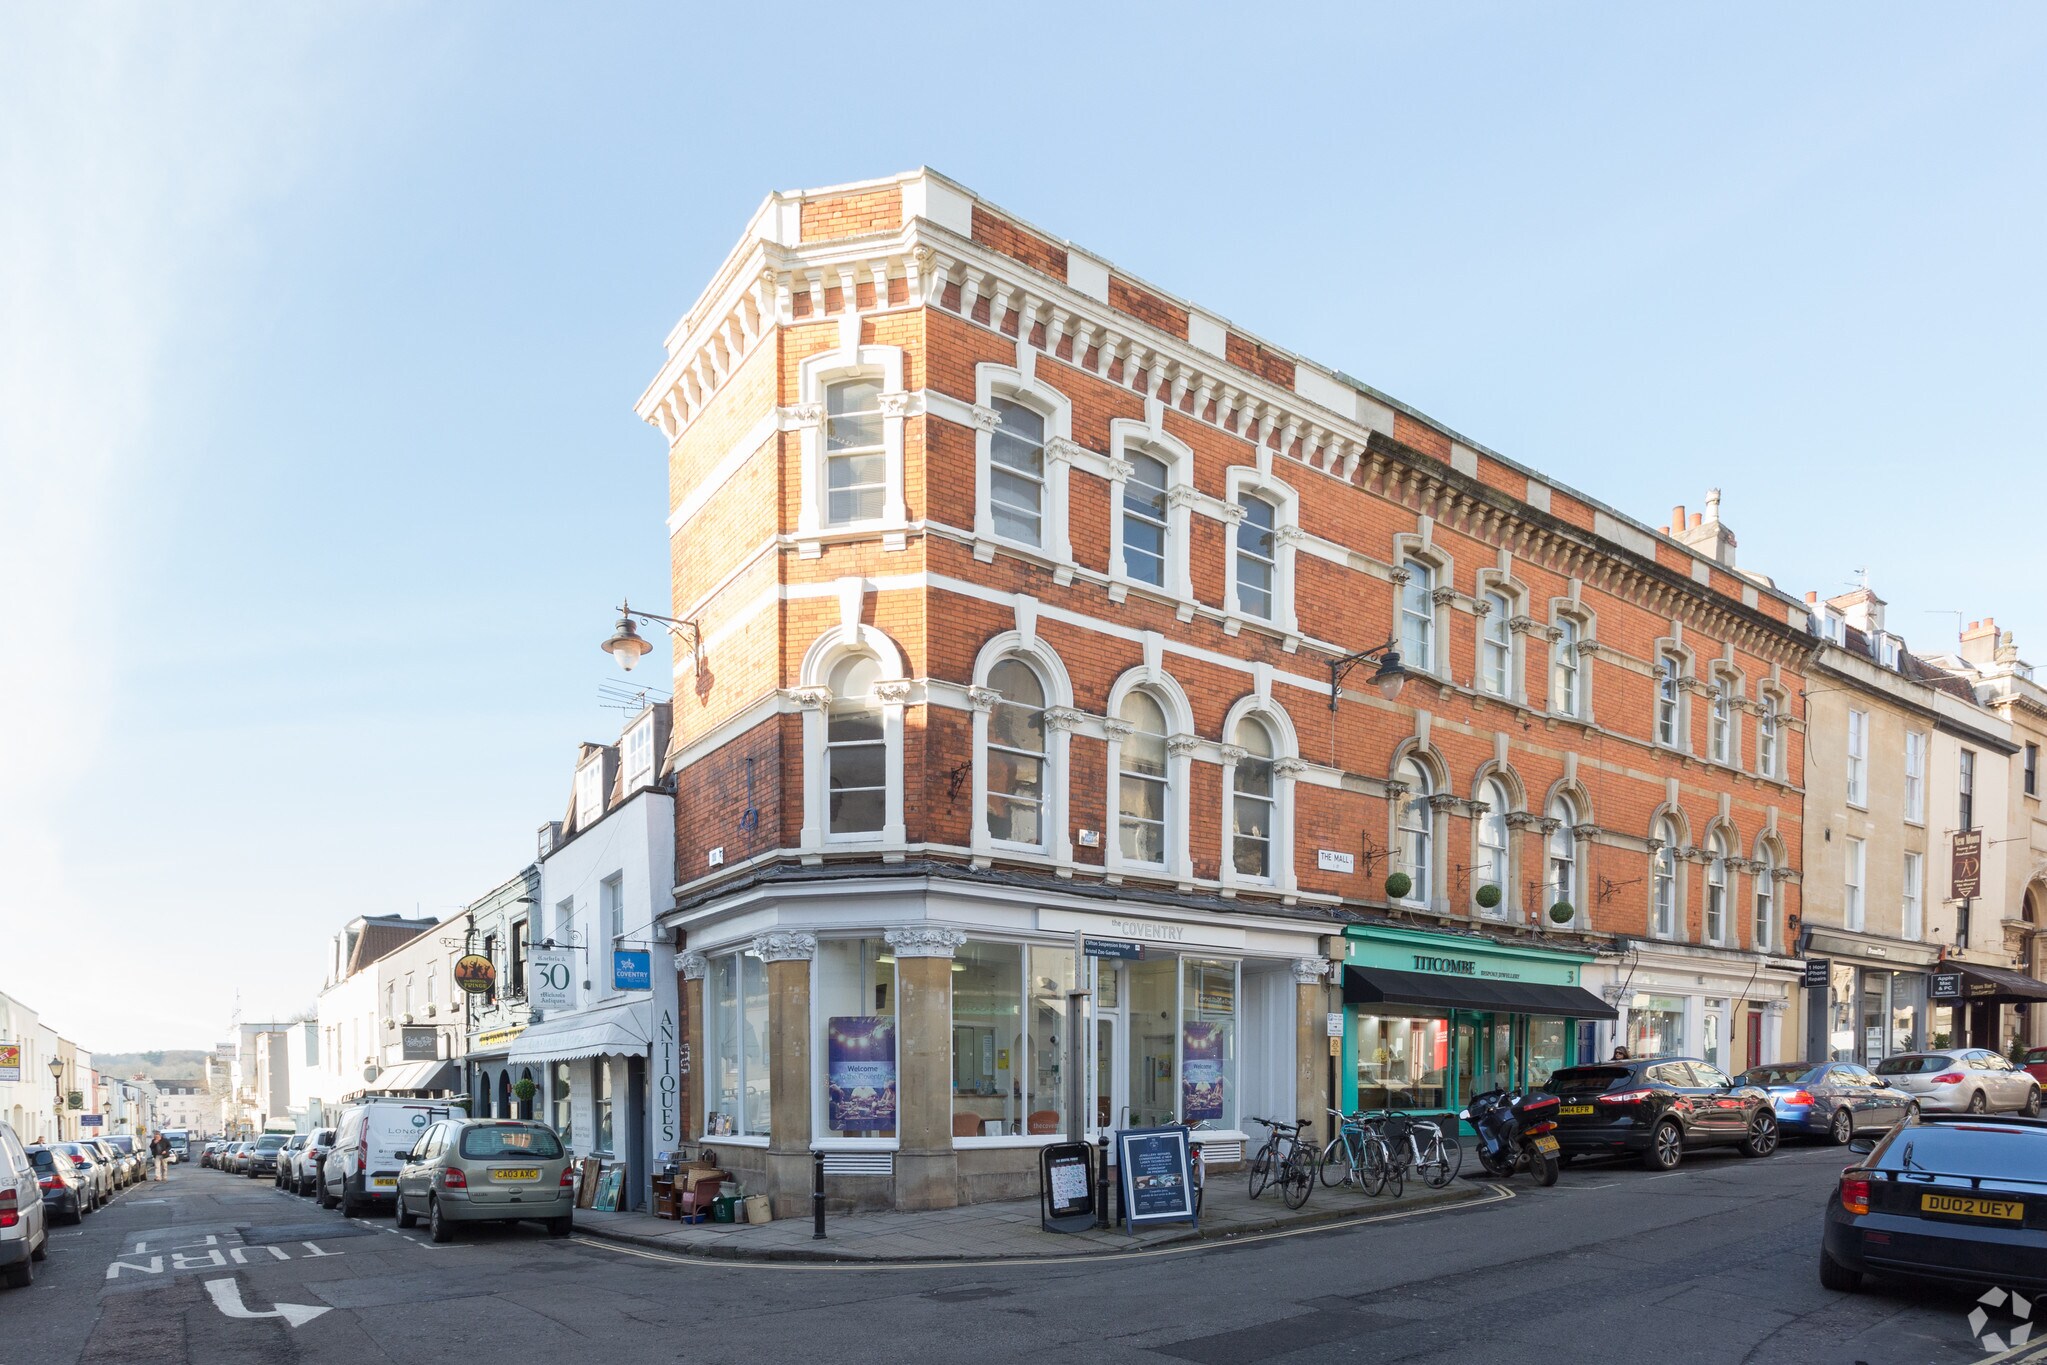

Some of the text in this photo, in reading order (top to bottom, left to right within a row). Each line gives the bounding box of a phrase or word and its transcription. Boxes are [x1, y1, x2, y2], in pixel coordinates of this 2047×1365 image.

[1320, 852, 1350, 864] THE MALL
[1111, 919, 1184, 940] the COVENTRY
[1098, 941, 1118, 949] Suspension
[1413, 955, 1476, 975] TITCOMBE
[534, 962, 570, 990] 30
[616, 970, 648, 978] COVENTRY
[1497, 971, 1520, 979] JEWELLERY
[1567, 970, 1574, 983] 3
[660, 1009, 676, 1142] ANTIQUES
[858, 1073, 887, 1081] Coventry
[1576, 1105, 1589, 1113] EFR
[520, 1170, 535, 1178] AXC
[1929, 1196, 2015, 1217] DU02 UEY
[106, 1241, 346, 1280] TURN
